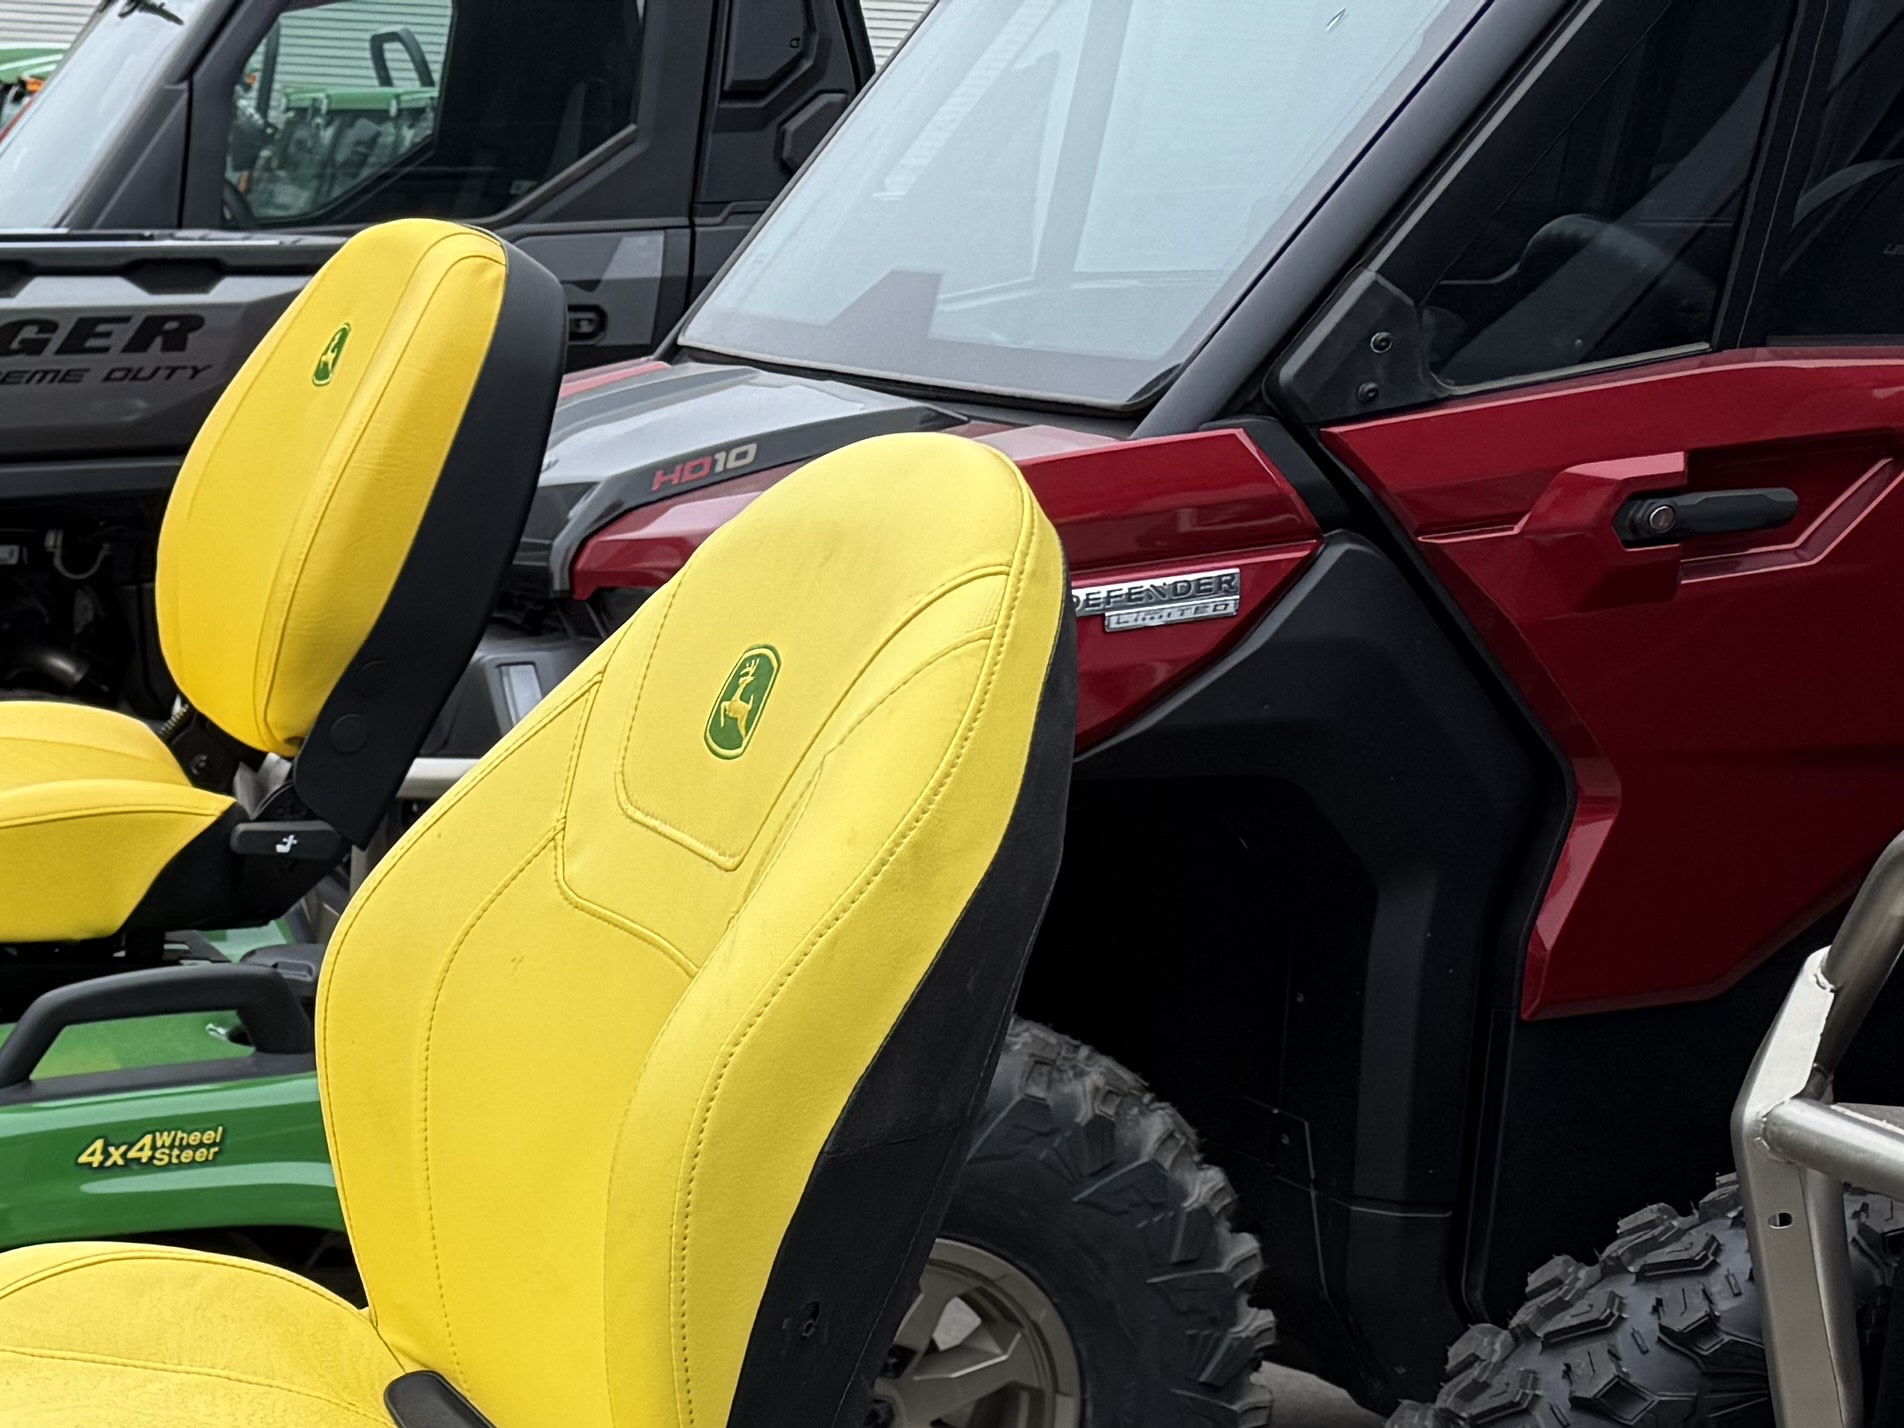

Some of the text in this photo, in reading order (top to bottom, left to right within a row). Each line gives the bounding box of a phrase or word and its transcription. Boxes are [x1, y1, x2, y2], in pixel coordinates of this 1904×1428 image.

[102, 364, 214, 382] DUTY
[651, 443, 757, 492] HD10
[77, 1126, 223, 1168] 4x4 Wheel
[153, 1146, 219, 1166] Steer
